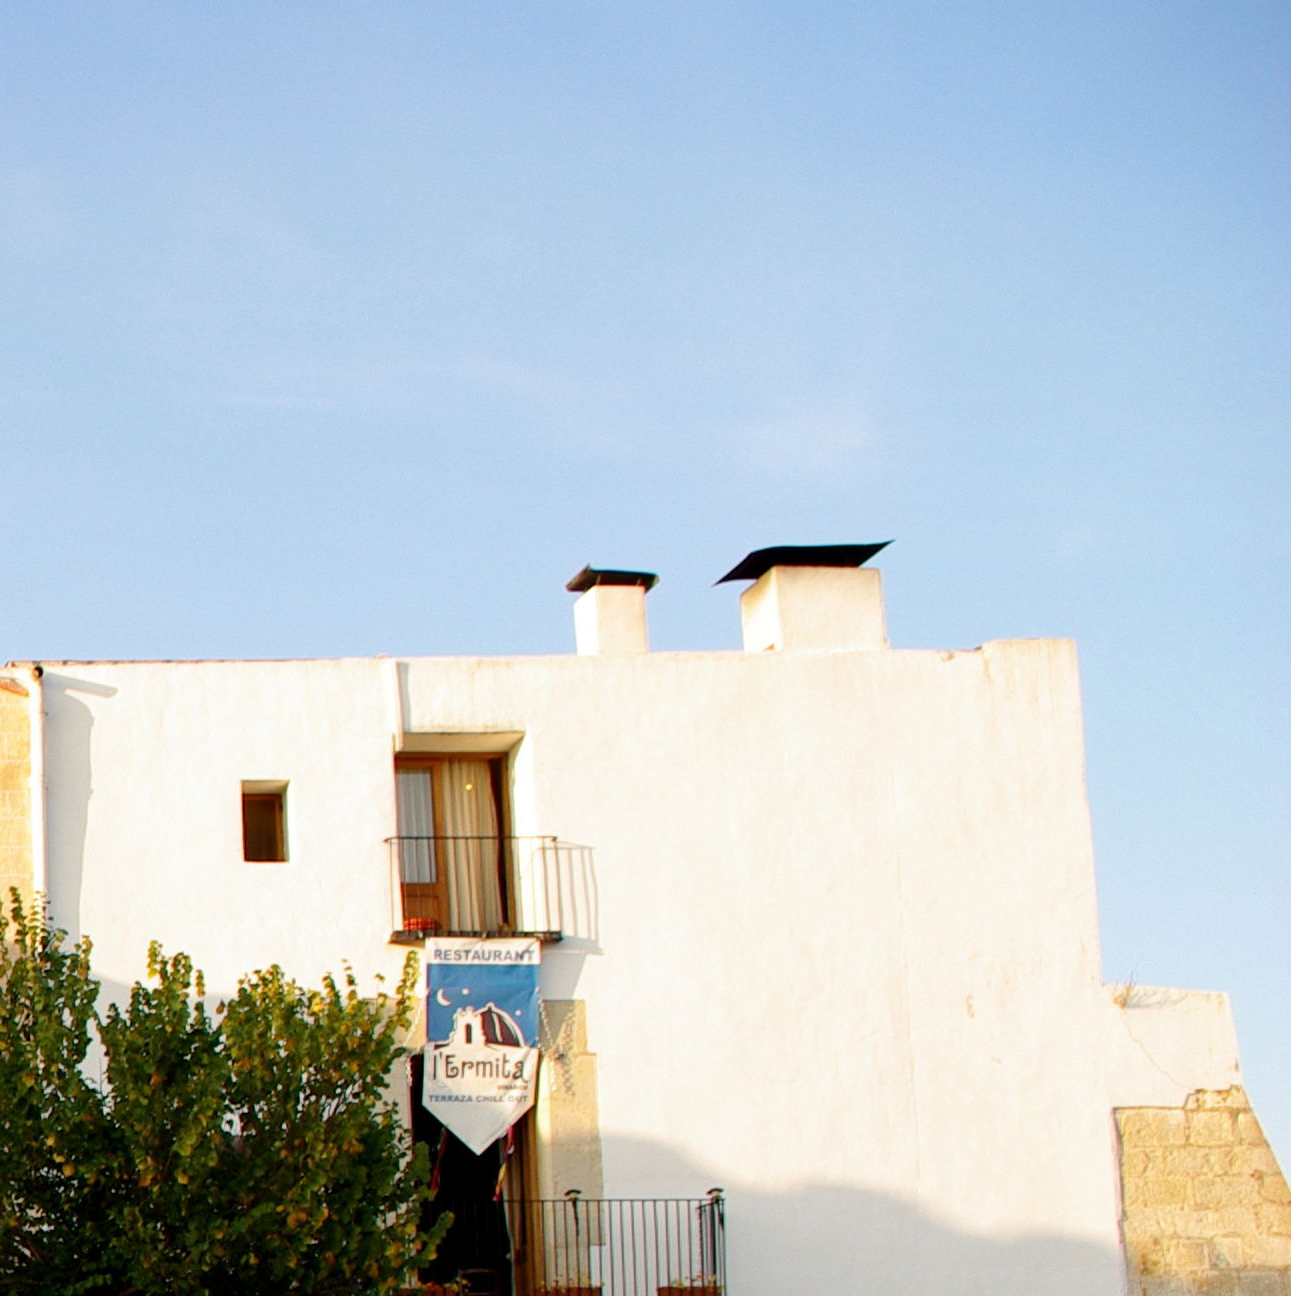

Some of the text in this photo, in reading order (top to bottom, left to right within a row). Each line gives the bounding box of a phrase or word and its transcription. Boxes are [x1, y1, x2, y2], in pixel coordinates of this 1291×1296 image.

[433, 948, 535, 962] RESTAURANT
[431, 1051, 529, 1082] l'Ermita
[428, 1094, 473, 1104] TERRAZA
